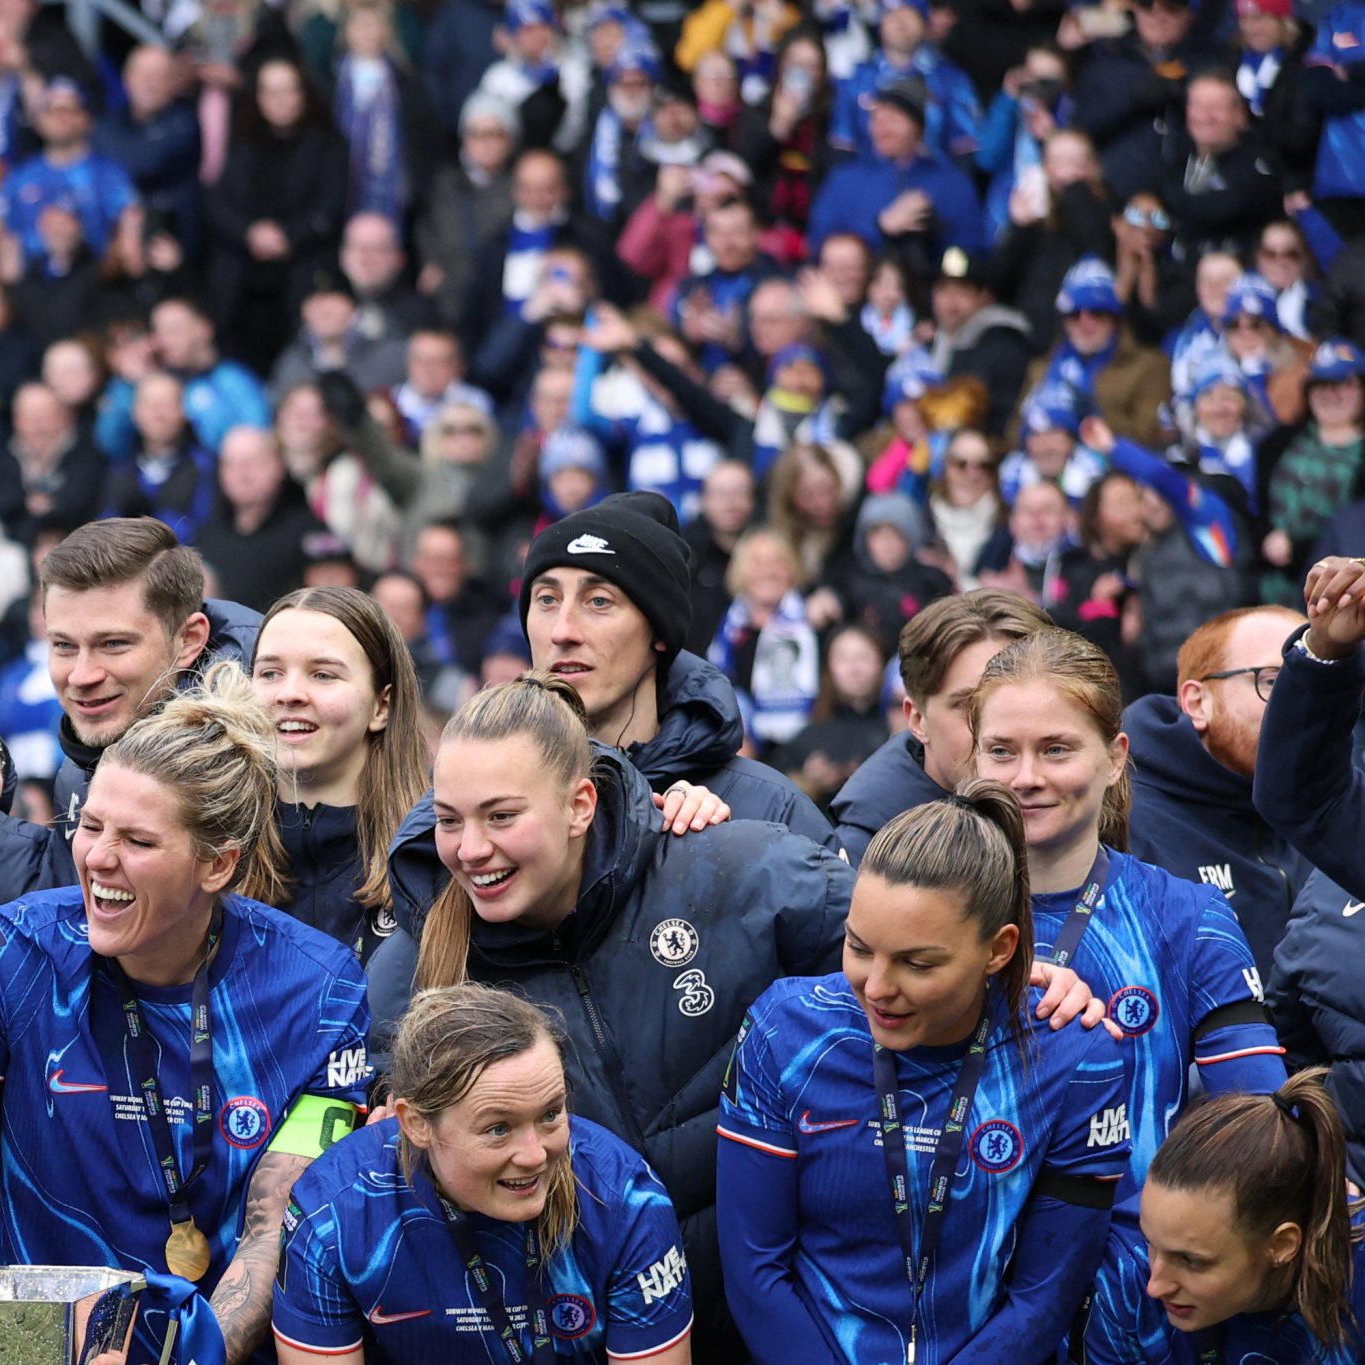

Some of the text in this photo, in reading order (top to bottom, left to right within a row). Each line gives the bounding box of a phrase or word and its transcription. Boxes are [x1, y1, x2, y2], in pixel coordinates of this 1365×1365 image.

[654, 919, 685, 936] CHELSEA
[329, 1048, 366, 1069] LIVE
[228, 1100, 263, 1112] CHELSEA
[1090, 1103, 1126, 1129] LIVE
[319, 1106, 353, 1151] C
[981, 1123, 1014, 1136] CHELSEA
[905, 1144, 935, 1153] ANCHESTER
[636, 1245, 681, 1290] LIVE
